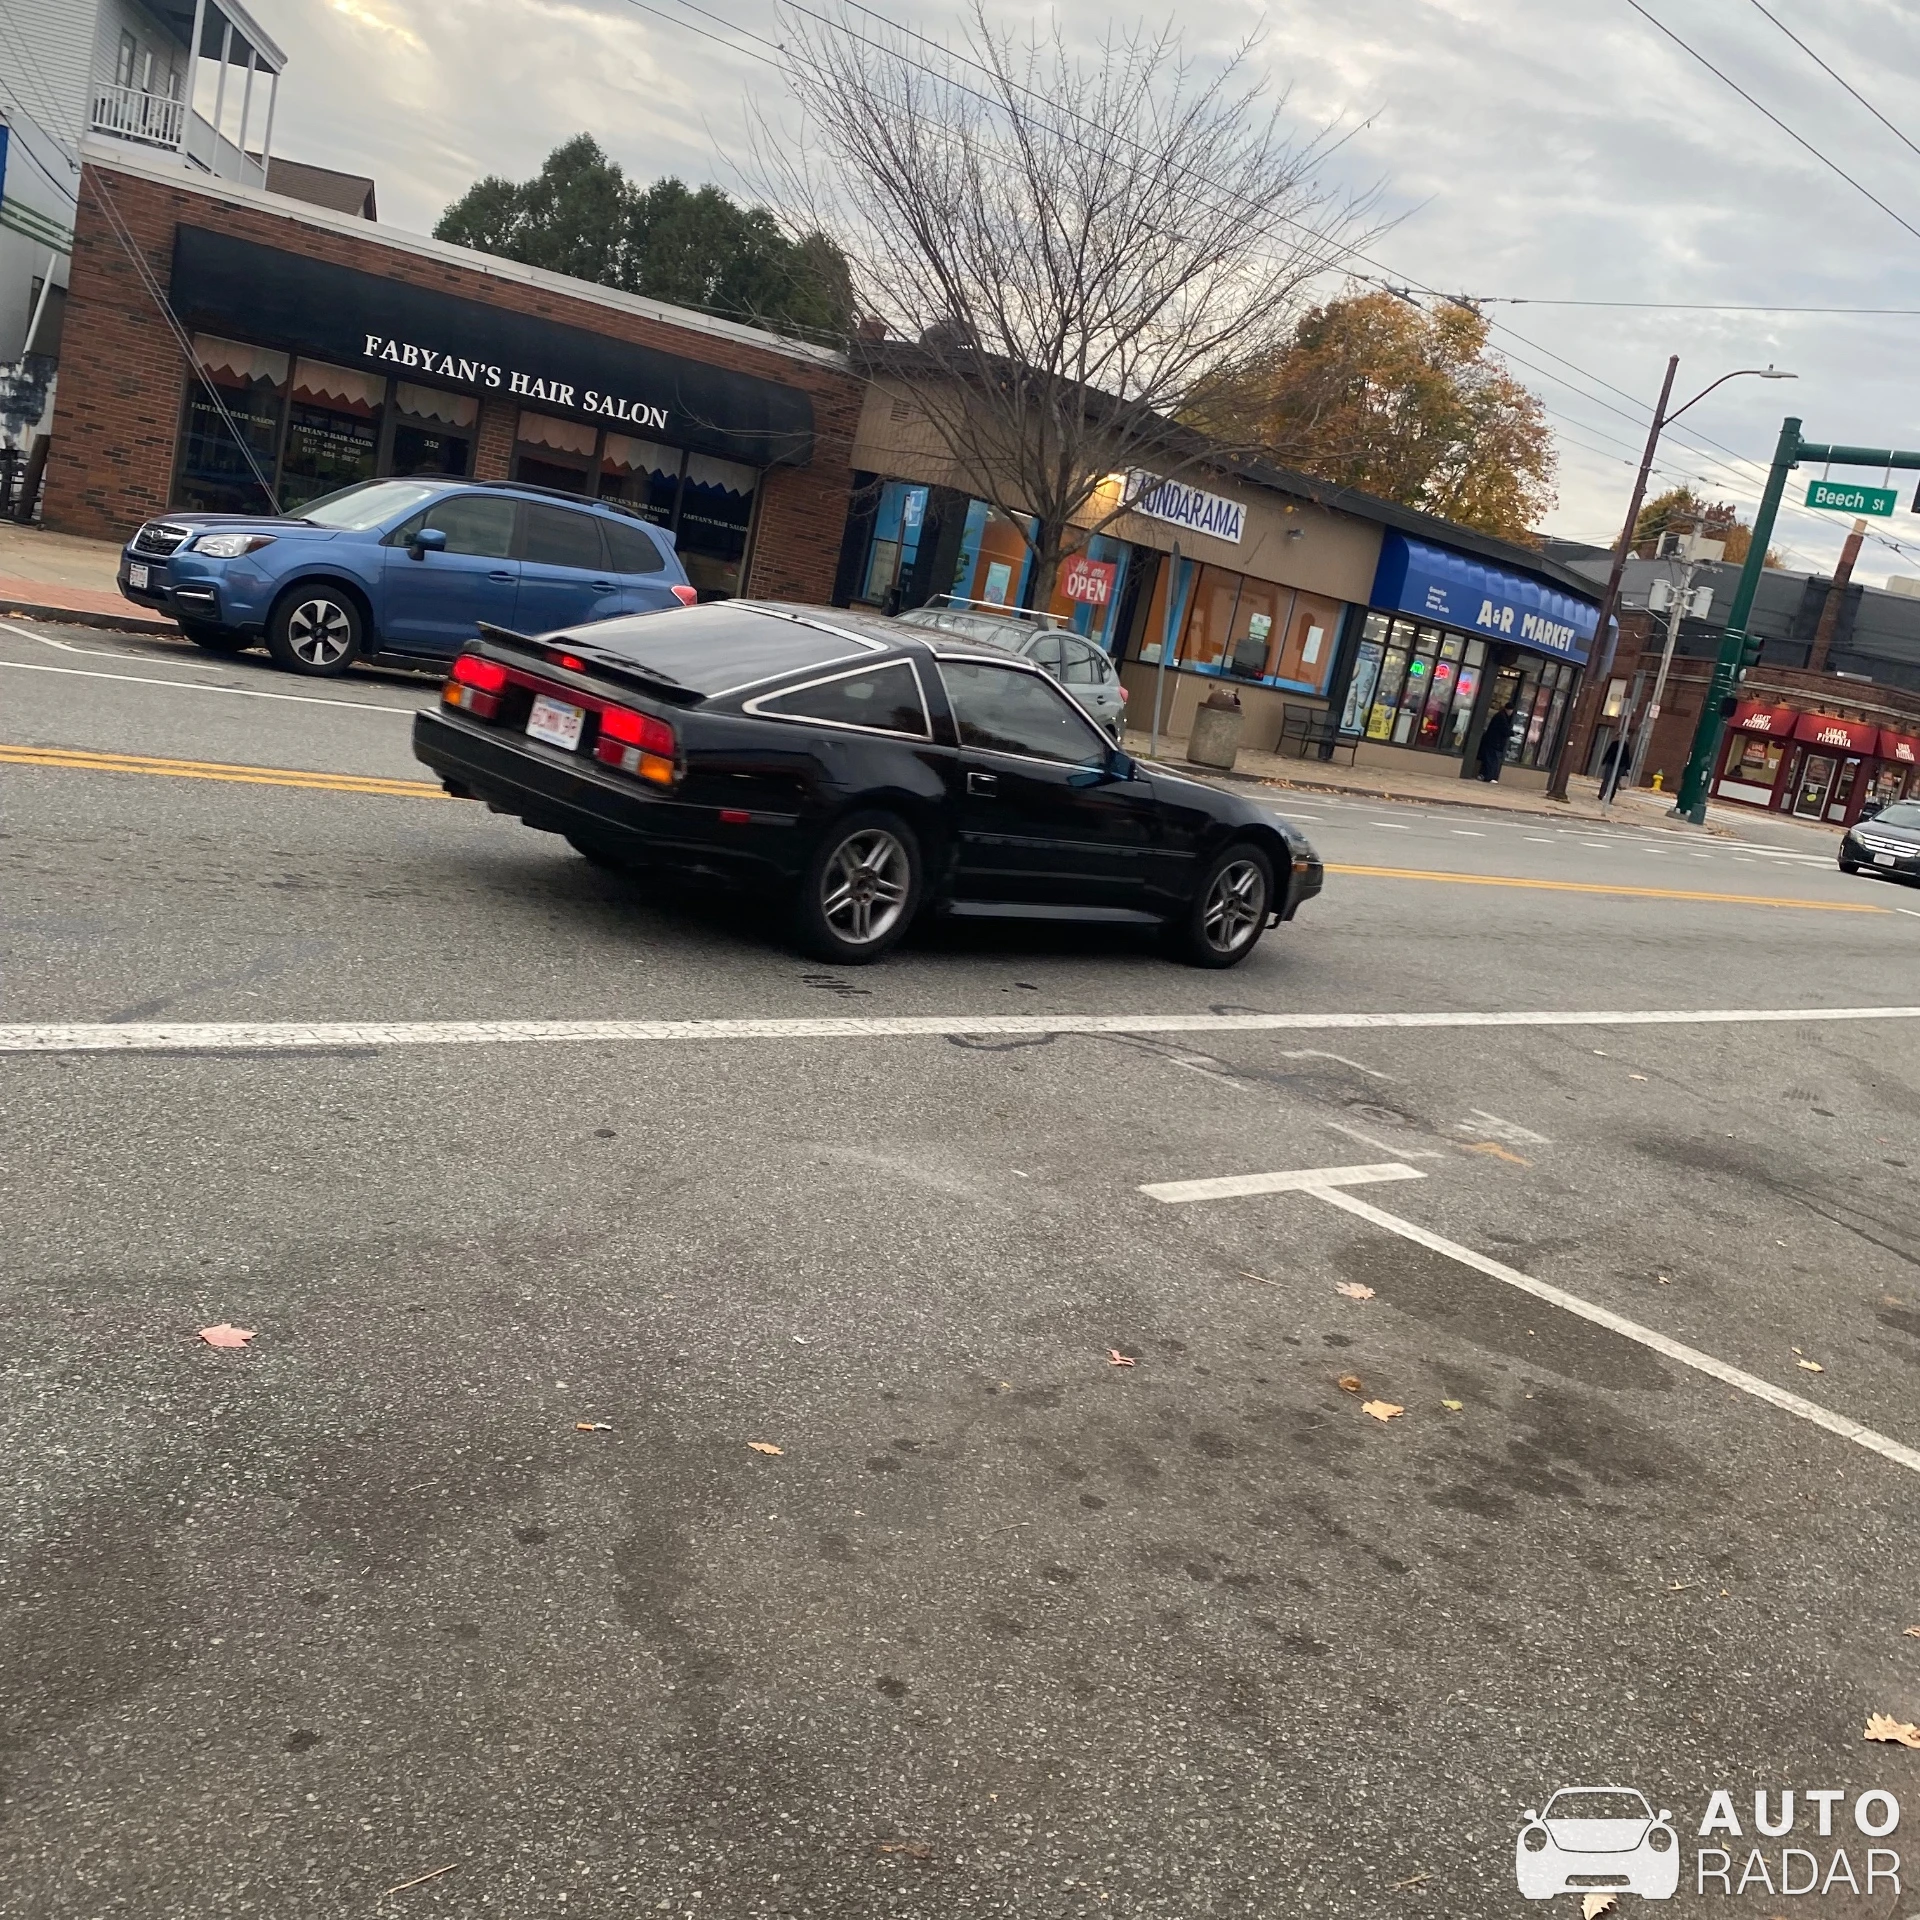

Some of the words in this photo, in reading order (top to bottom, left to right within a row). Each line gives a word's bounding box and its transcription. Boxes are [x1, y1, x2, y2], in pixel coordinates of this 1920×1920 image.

[363, 334, 501, 387] FABYAN'S
[508, 371, 575, 407] HAIR
[583, 391, 668, 429] SALON
[231, 411, 249, 420] HAIR
[251, 415, 276, 426] SALON
[293, 424, 328, 438] FABYAN'S
[330, 432, 348, 442] HAIR
[350, 436, 373, 447] SALON
[424, 439, 439, 449] 352
[1815, 487, 1864, 508] Beech
[1872, 498, 1885, 511] St
[650, 505, 670, 515] SALON
[1075, 560, 1089, 575] We
[1067, 572, 1107, 602] OPEN
[1476, 600, 1514, 633] A&R
[1520, 613, 1575, 651] MARKET
[1816, 732, 1851, 748] PIZZERIA
